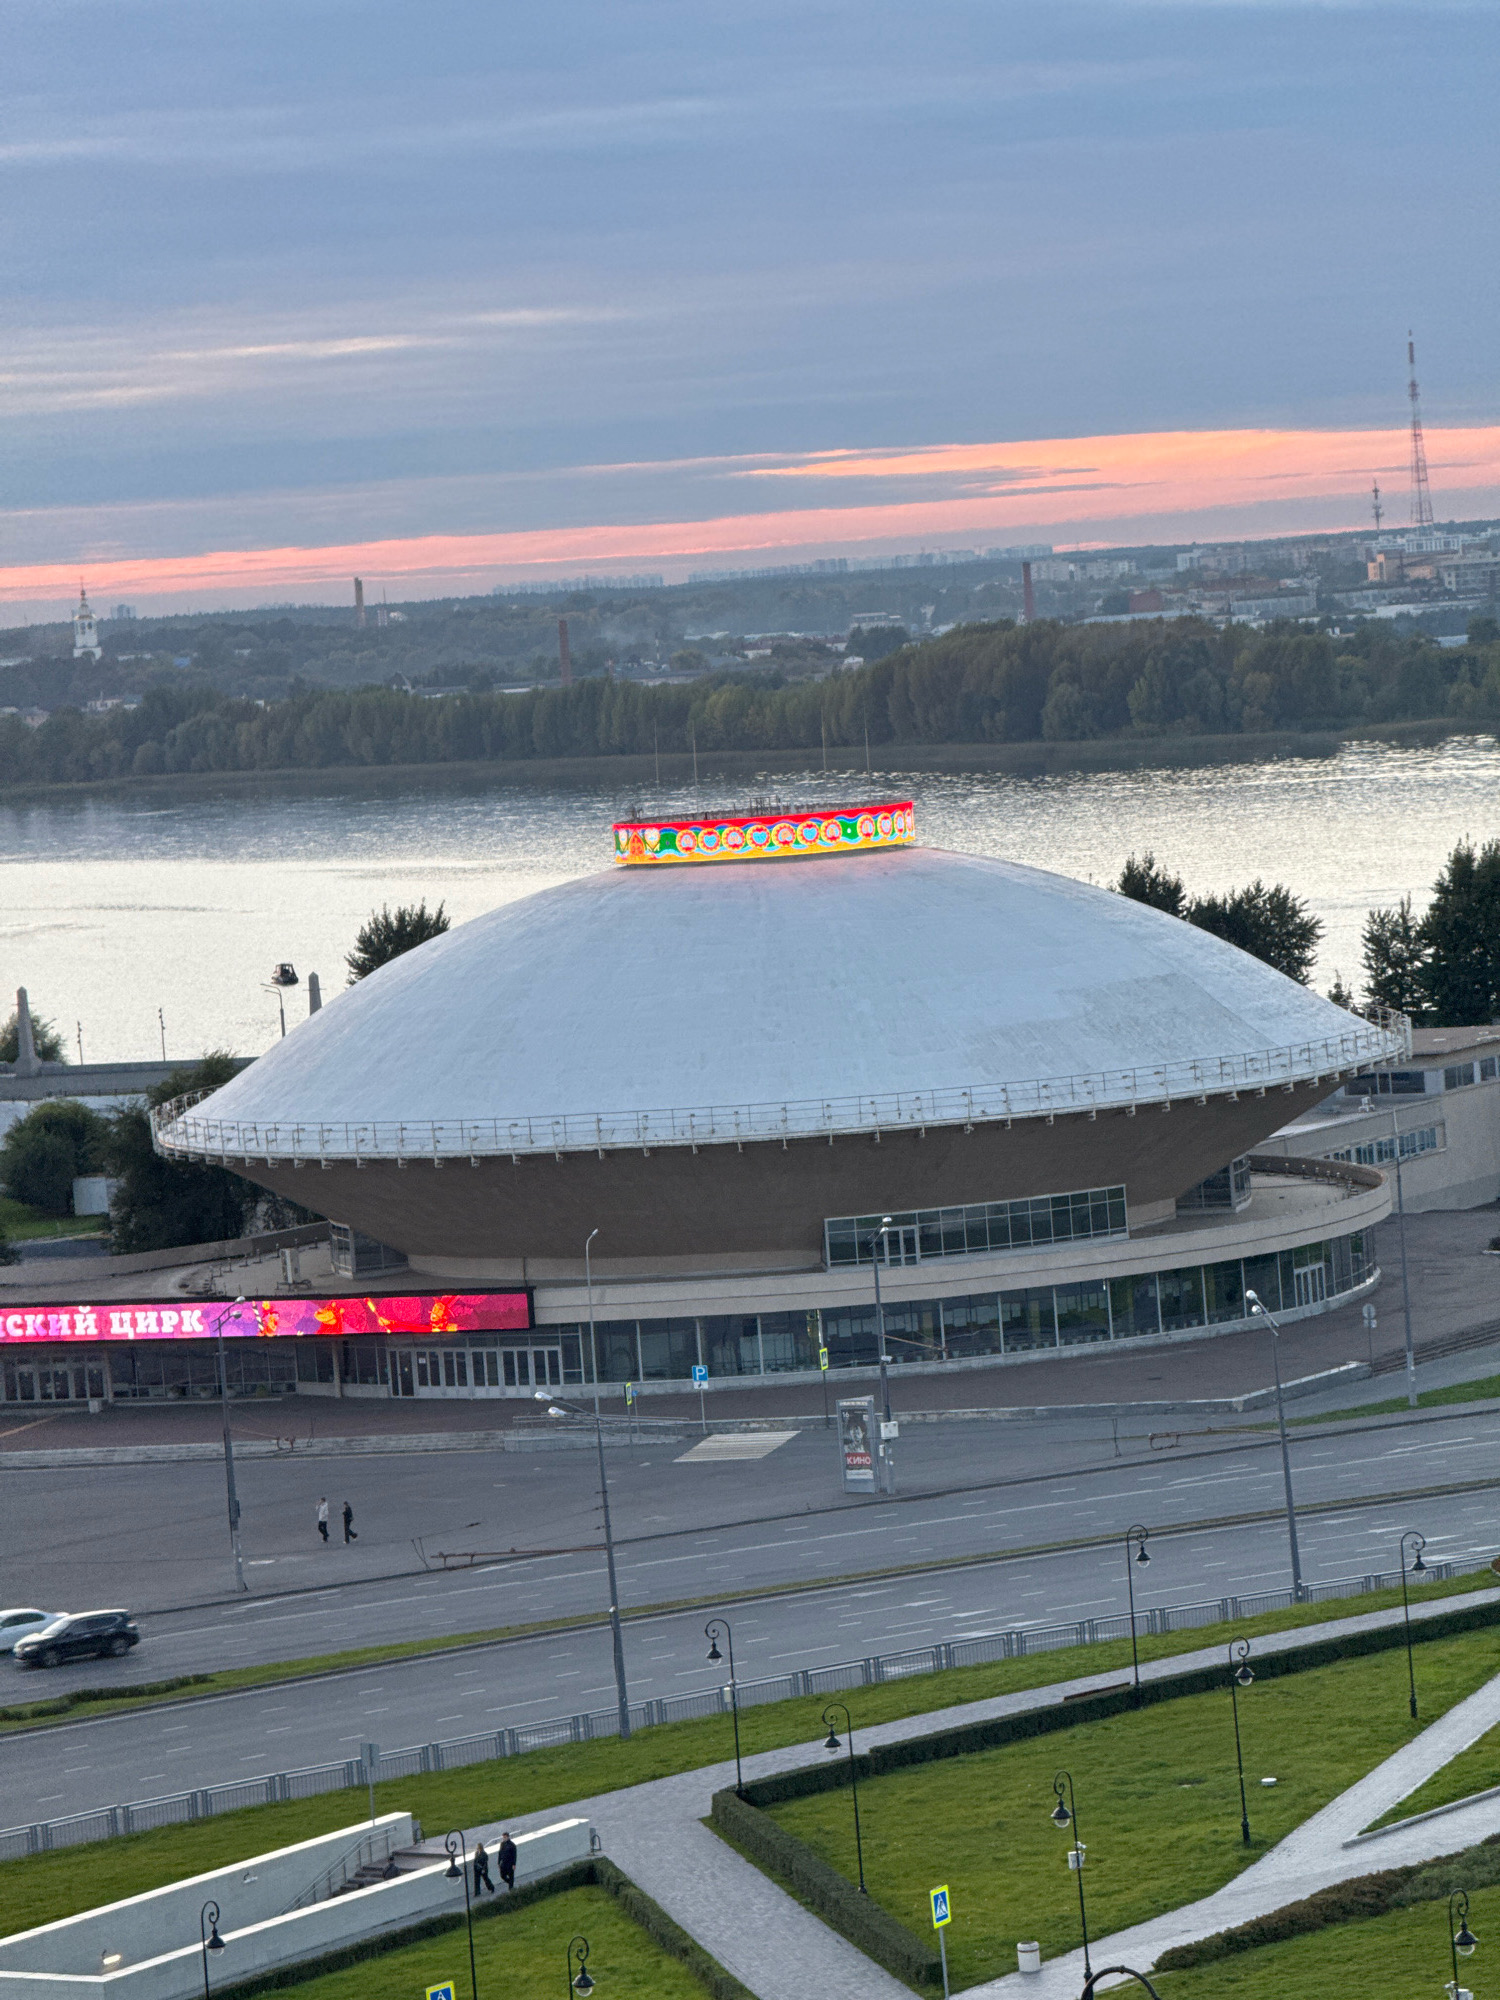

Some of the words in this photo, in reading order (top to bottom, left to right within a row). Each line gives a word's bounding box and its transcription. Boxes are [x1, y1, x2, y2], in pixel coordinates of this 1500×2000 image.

[109, 1309, 204, 1340] ЦИРК
[696, 1367, 706, 1380] P
[846, 1456, 872, 1465] КИНО
